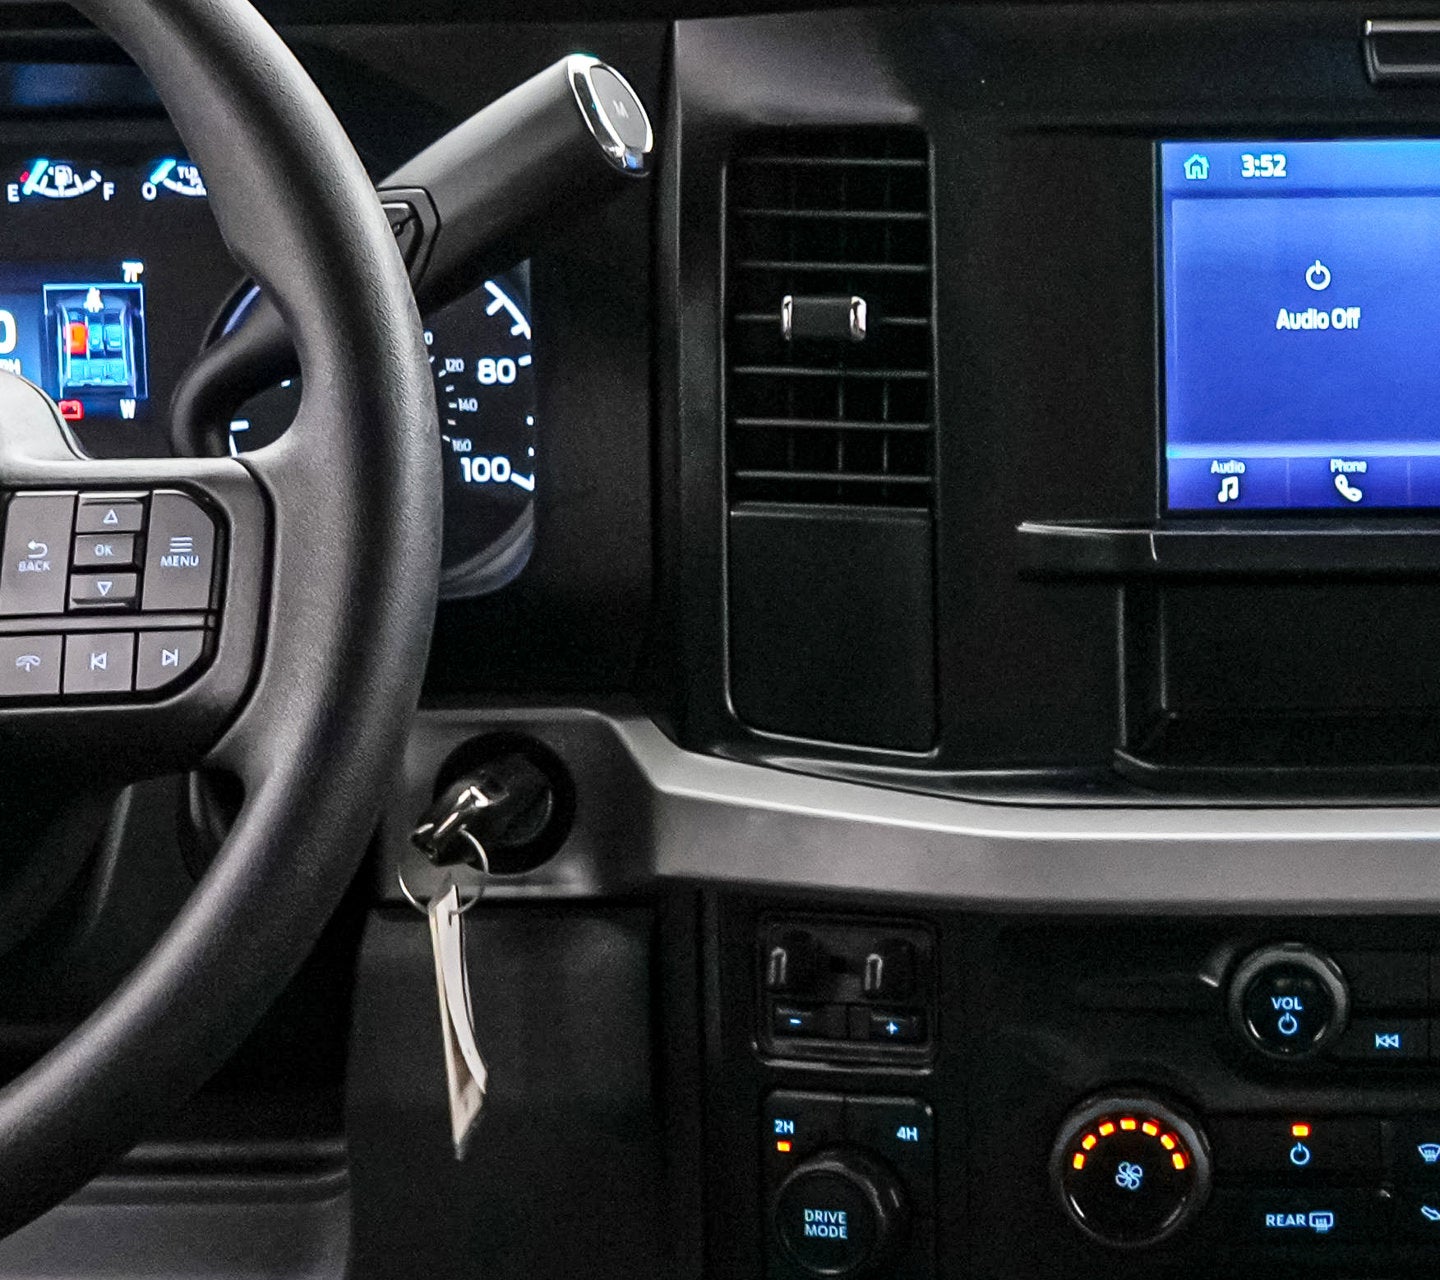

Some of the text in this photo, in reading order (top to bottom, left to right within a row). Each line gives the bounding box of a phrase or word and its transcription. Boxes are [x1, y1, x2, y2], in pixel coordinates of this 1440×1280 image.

[1240, 153, 1287, 178] 3:52
[7, 183, 20, 203] E
[103, 181, 115, 202] F
[1275, 306, 1361, 331] Audio Off
[477, 358, 517, 385] 80
[119, 398, 137, 419] W
[459, 456, 512, 483] 100
[1210, 459, 1246, 475] Audio
[1330, 457, 1368, 474] Phone
[94, 543, 114, 557] OK
[18, 559, 51, 573] BACK
[160, 554, 200, 568] MENU
[1271, 996, 1303, 1011] VOL
[773, 1119, 795, 1135] 2H
[896, 1126, 919, 1142] 4H
[804, 1208, 848, 1225] DRIVE
[1265, 1213, 1307, 1228] REAR
[804, 1223, 849, 1240] MODE
